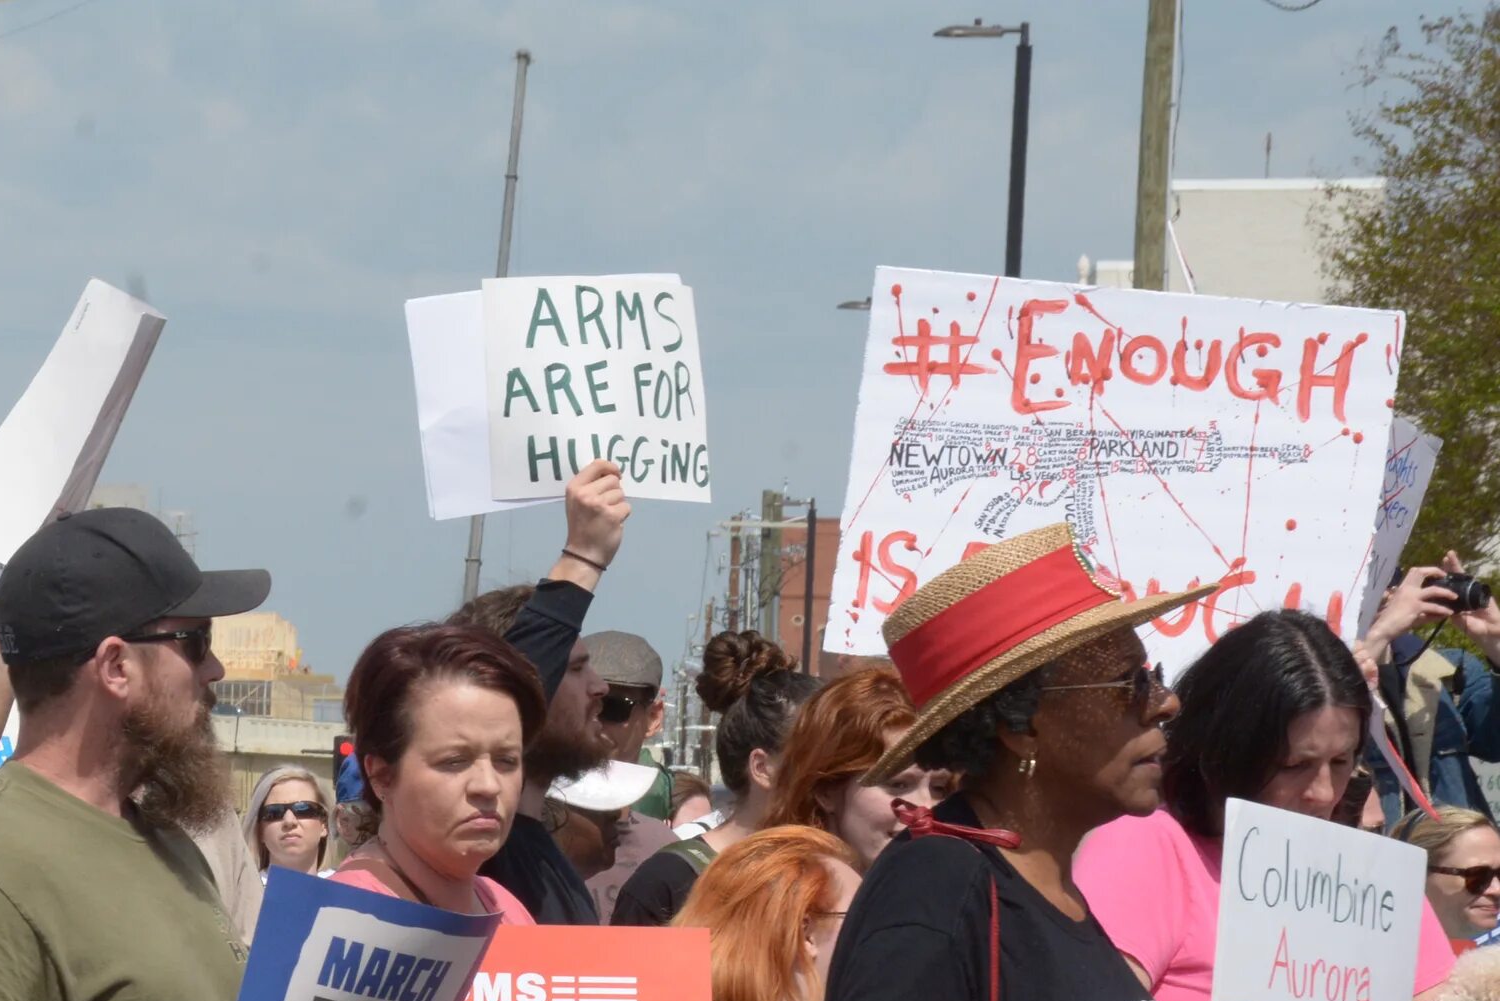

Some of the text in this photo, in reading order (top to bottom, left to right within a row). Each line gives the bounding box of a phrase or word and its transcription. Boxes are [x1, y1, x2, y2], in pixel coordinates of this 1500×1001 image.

[525, 284, 683, 353] ARMS
[503, 360, 696, 421] ARE FOR
[889, 443, 1009, 468] NEWTOWN
[1009, 446, 1040, 467] 28
[1089, 438, 1180, 460] PARKLAND
[929, 465, 975, 486] AURORA
[1238, 826, 1395, 932] Columbine
